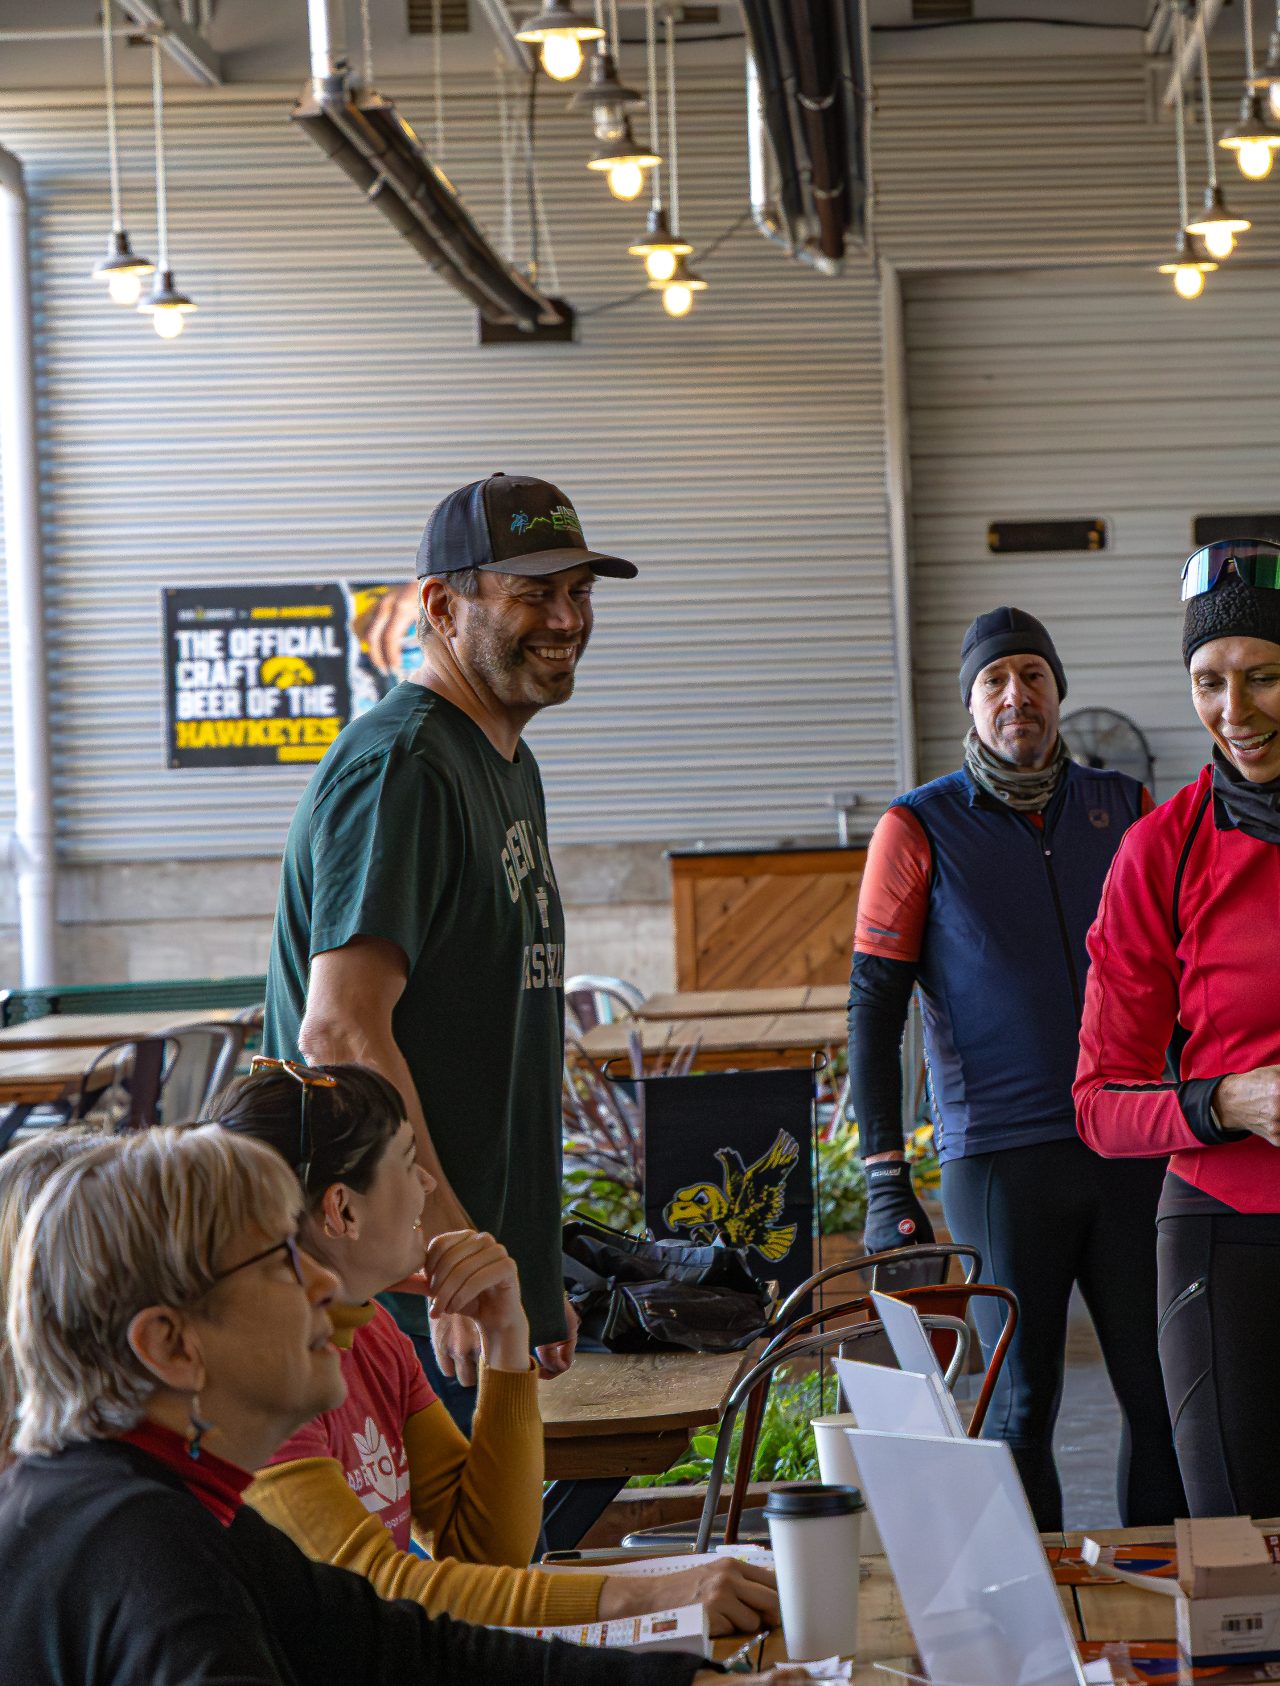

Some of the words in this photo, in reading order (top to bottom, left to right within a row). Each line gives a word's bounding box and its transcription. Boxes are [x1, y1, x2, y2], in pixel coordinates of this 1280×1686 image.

[174, 629, 225, 658] THE
[228, 626, 342, 657] OFFICIAL
[175, 659, 260, 689] CRAFT
[175, 689, 243, 719] BEER
[245, 687, 281, 717] OF
[286, 684, 337, 715] THE
[175, 717, 342, 748] HAWKEYES
